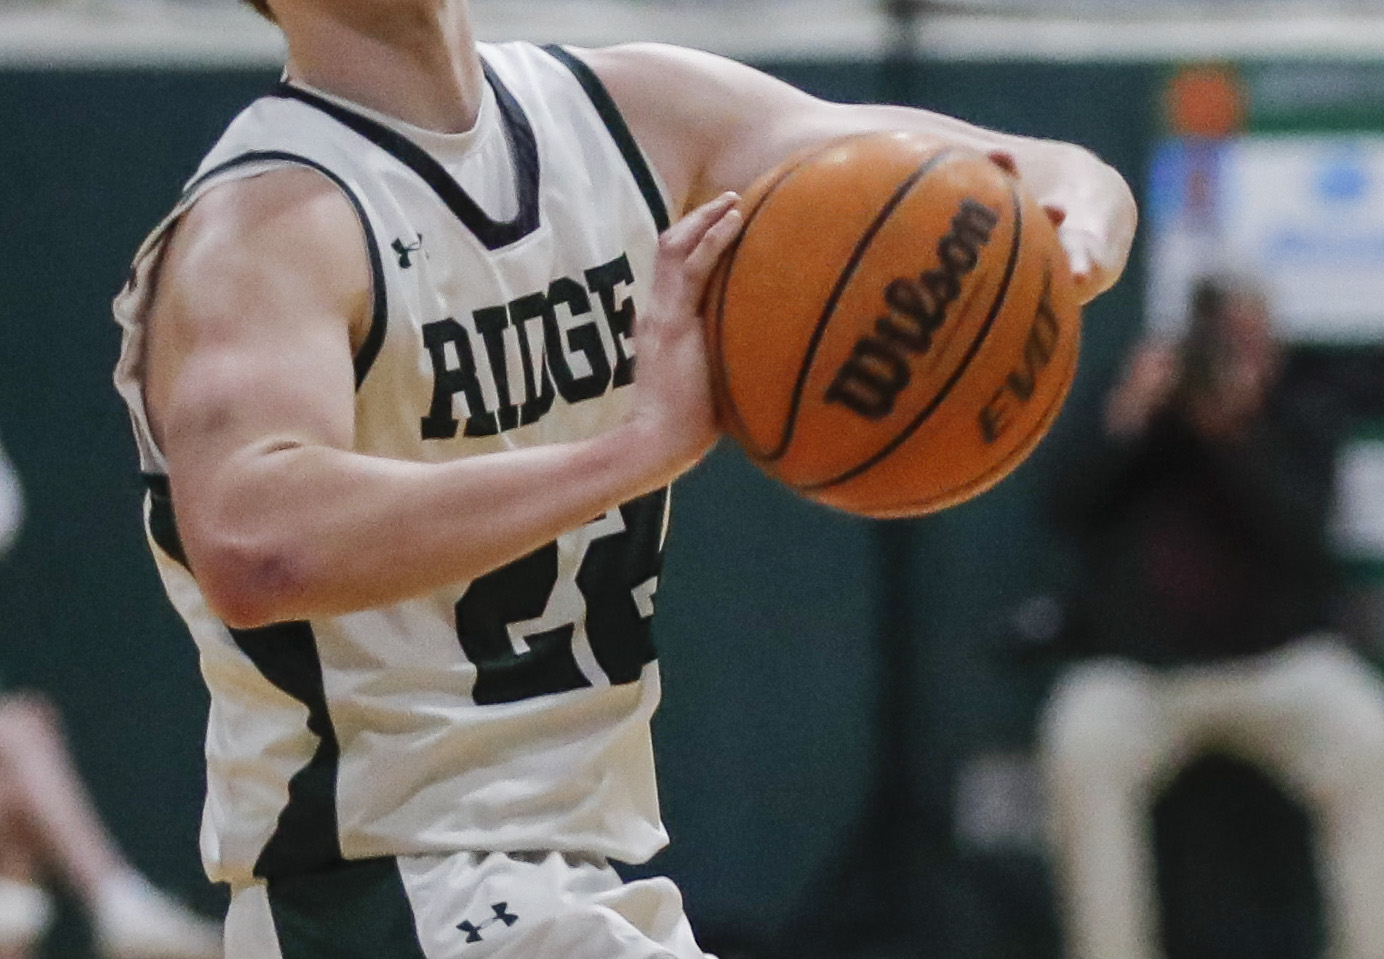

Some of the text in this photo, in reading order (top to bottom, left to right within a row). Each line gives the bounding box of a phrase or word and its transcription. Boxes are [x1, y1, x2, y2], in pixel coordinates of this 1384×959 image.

[420, 251, 636, 440] RIDGE
[824, 197, 1001, 422] Wilson
[454, 485, 668, 706] 22
